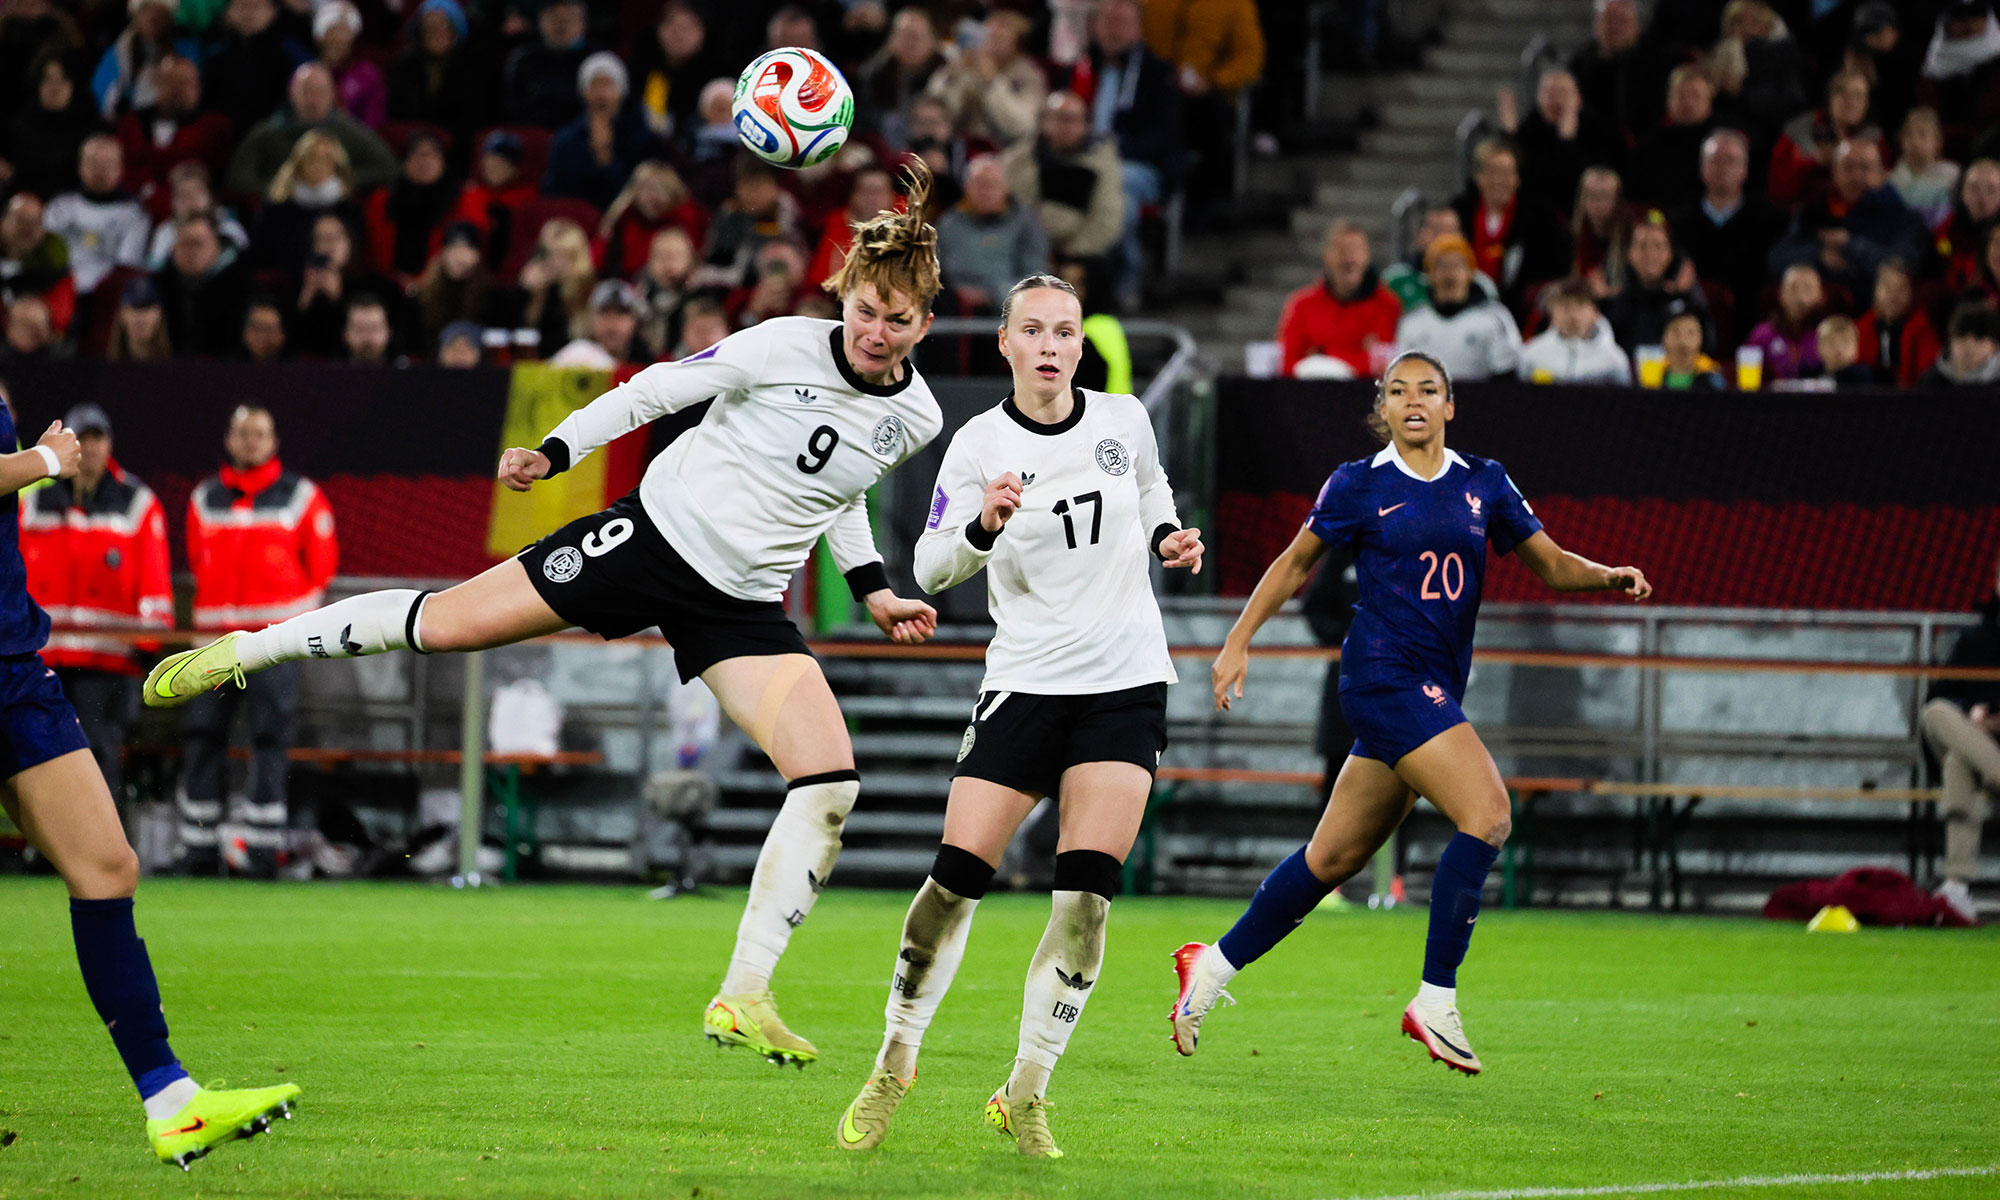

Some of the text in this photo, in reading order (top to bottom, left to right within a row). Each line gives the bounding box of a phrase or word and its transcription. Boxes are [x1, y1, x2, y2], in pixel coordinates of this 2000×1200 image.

[797, 425, 839, 474] 9
[581, 518, 635, 557] 9
[1051, 490, 1102, 549] 17
[1419, 550, 1464, 601] 20
